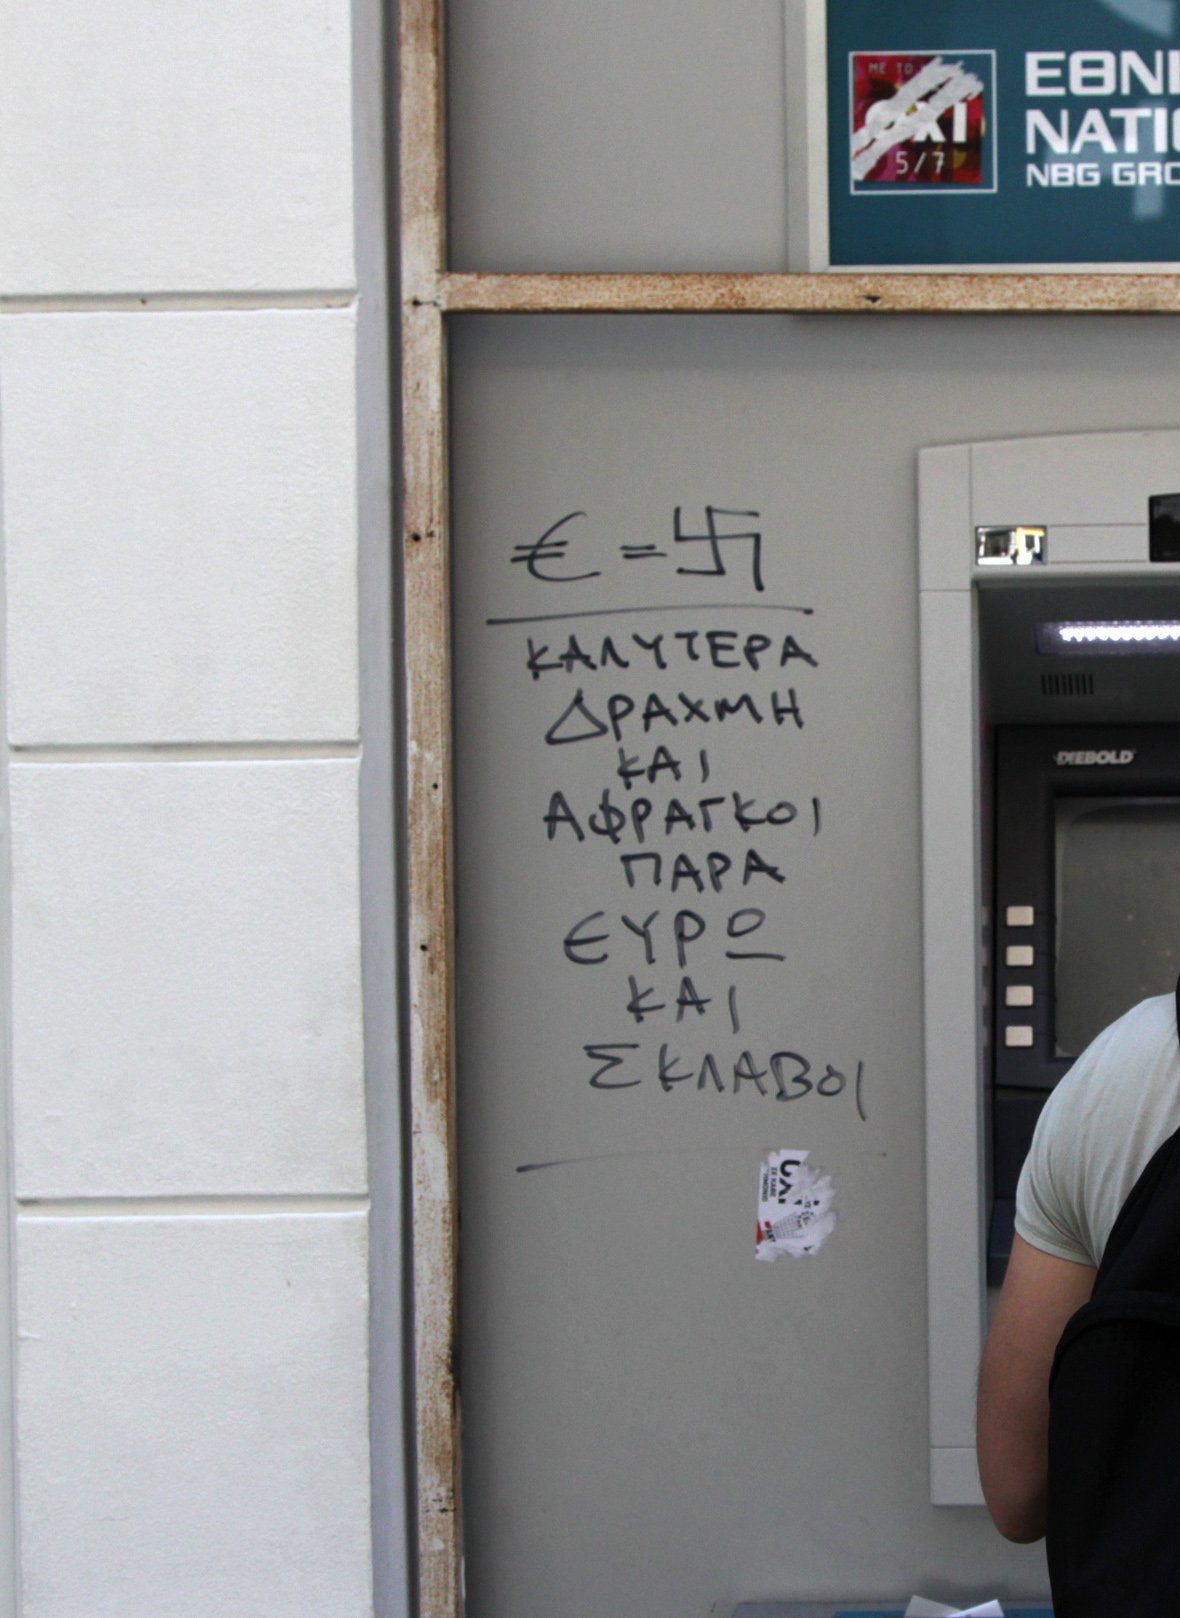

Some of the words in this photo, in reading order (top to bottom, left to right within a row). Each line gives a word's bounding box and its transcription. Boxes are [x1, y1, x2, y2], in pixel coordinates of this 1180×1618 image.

[895, 151, 945, 175] 5/7
[1026, 163, 1101, 188] NBG
[527, 630, 818, 680] ΚΑΛΥΤΕΡΑ
[545, 688, 804, 745] ΔΡΑΧΜΗ
[617, 745, 710, 790] ΚΑΙ
[1056, 750, 1135, 766] DIEBOLD
[543, 788, 821, 843] ΑΦΡΑΓΚΟΙ
[621, 849, 786, 893] ΠΑΡΑ
[626, 975, 740, 1034] ΚΑΙ
[583, 1042, 868, 1121] ΣΚΛΑΒΟΙ
